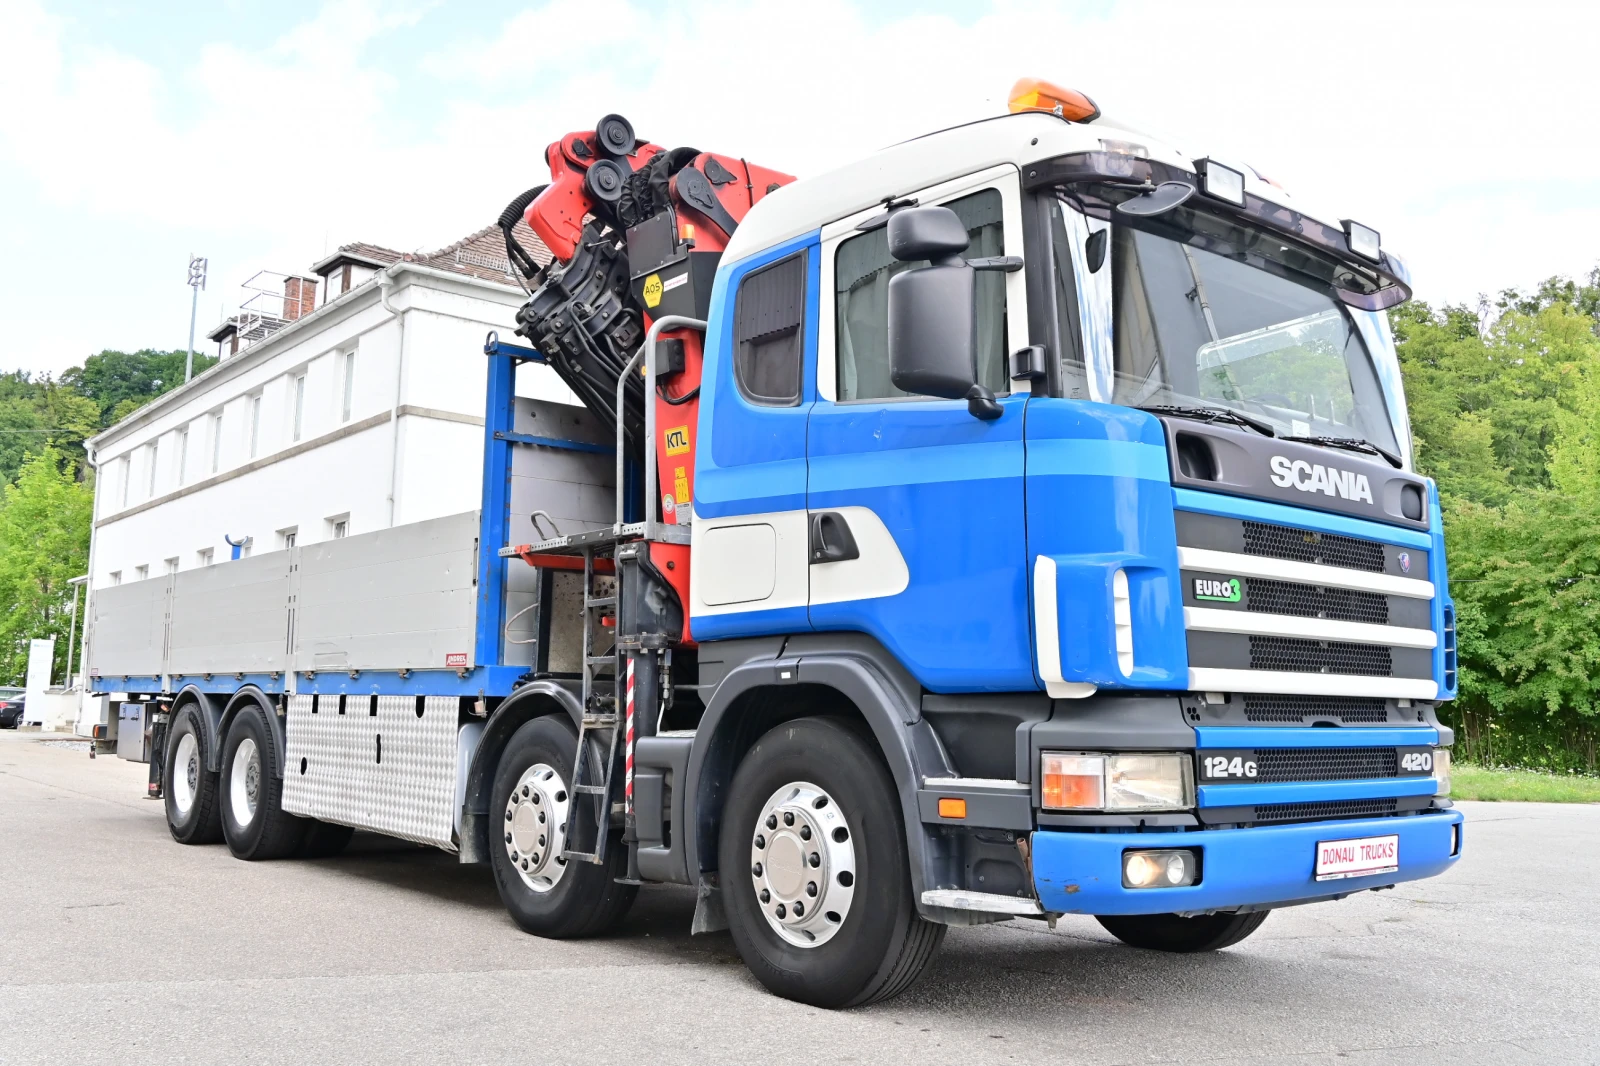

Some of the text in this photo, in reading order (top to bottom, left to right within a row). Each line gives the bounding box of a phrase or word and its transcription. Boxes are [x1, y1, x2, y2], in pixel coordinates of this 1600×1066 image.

[645, 282, 661, 295] AOS
[667, 431, 687, 448] KTL
[1270, 456, 1374, 505] SCANIA
[1195, 579, 1241, 602] EURO3
[1204, 757, 1257, 778] 124G
[1401, 753, 1432, 771] 420
[1322, 843, 1394, 865] DONAU TRUCKS
